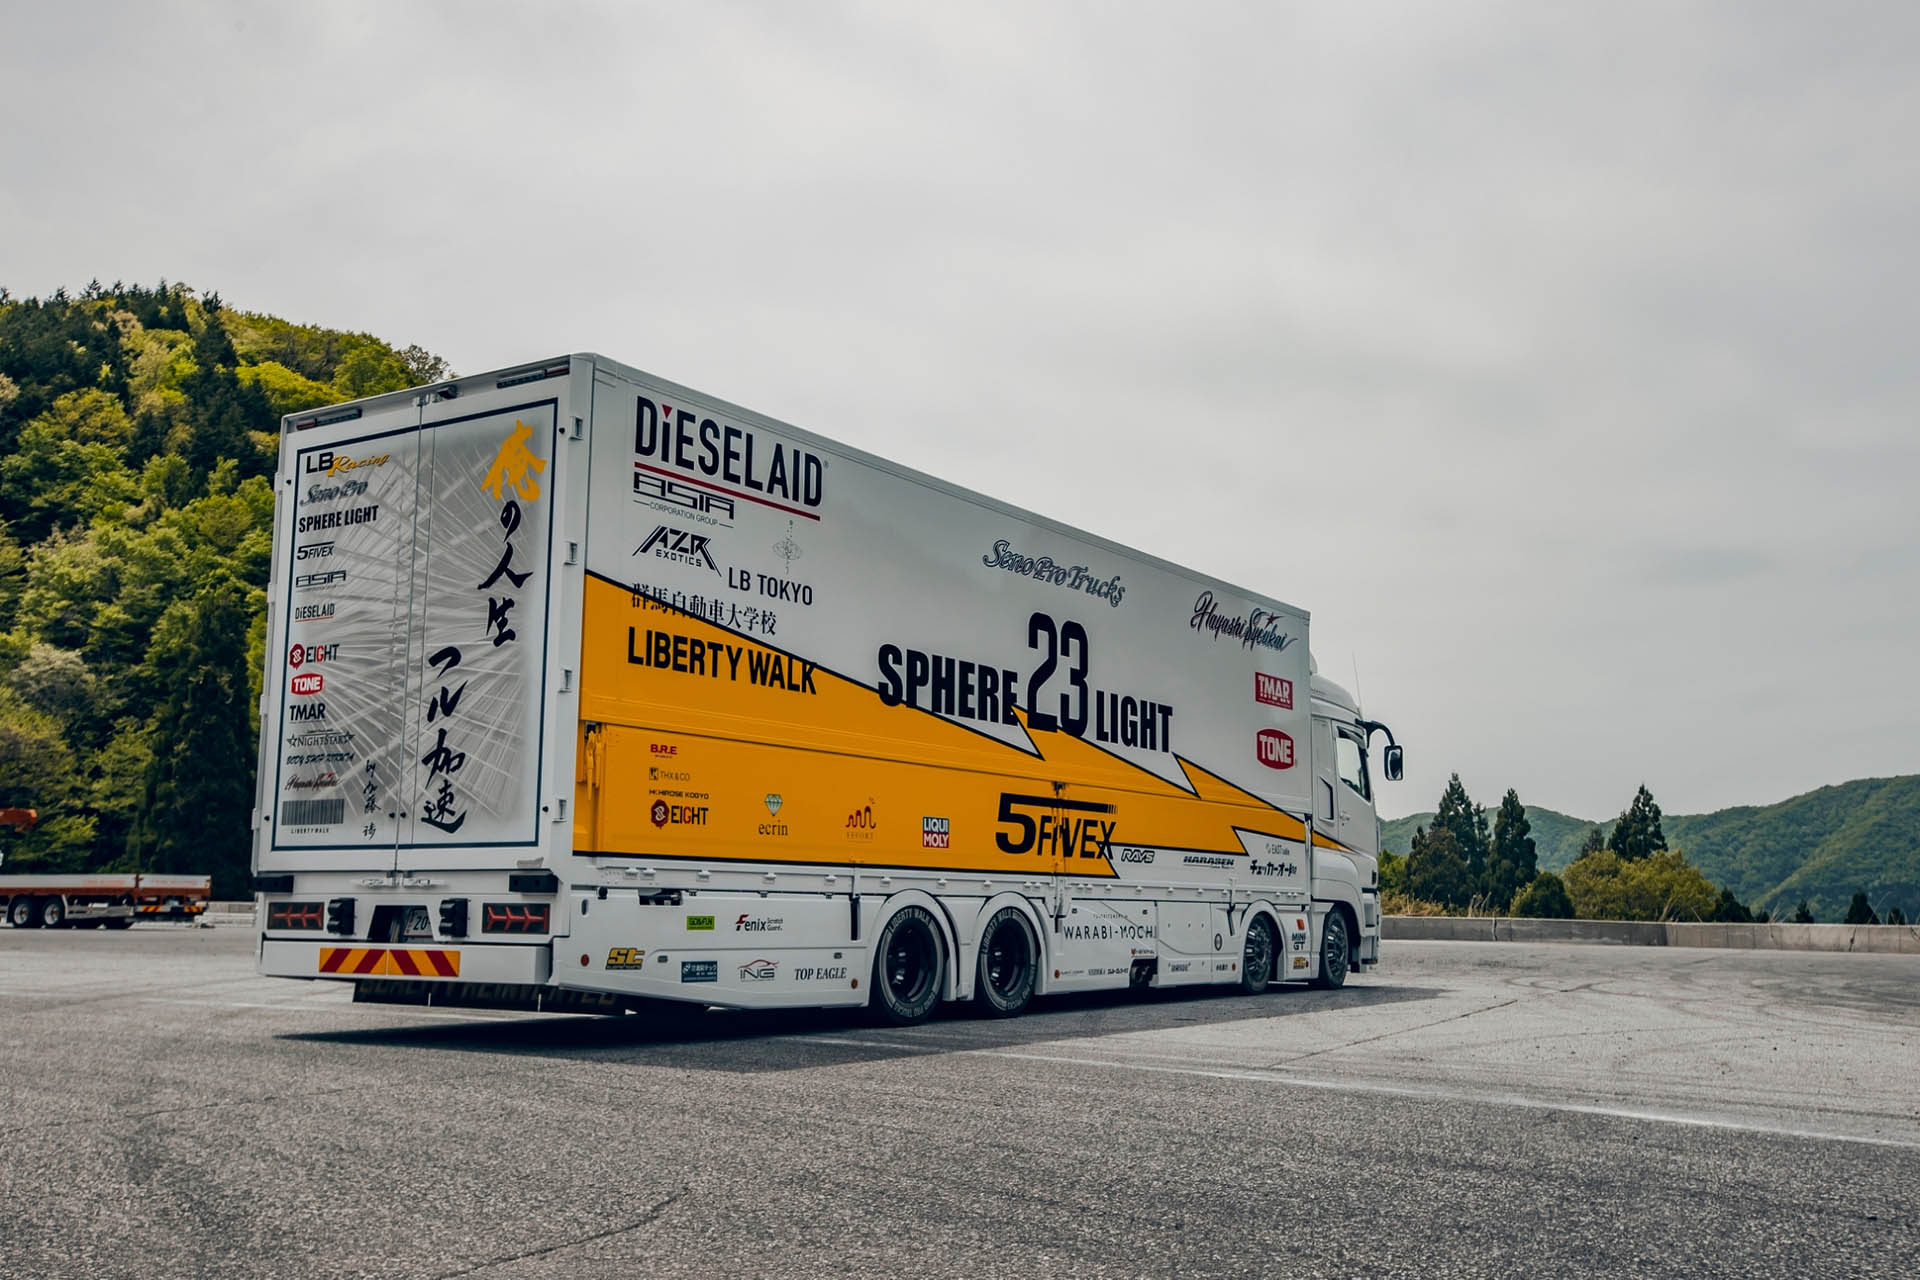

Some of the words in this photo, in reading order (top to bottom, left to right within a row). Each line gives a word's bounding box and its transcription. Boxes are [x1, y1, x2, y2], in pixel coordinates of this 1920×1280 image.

[306, 452, 333, 474] LB
[328, 454, 390, 477] Racing
[299, 511, 342, 533] SPHERE
[345, 505, 379, 526] LIGHT
[649, 501, 695, 520] CORPORATION
[696, 512, 718, 526] GROUP
[656, 549, 702, 568] EXOTICS
[983, 540, 1034, 576] Seno
[1033, 557, 1066, 586] Pro
[1067, 566, 1125, 607] Trucks
[729, 567, 750, 591] LB
[757, 573, 812, 606] TOKYO
[631, 582, 776, 636] 群馬自動車大学校
[306, 645, 340, 663] EIGHT
[628, 626, 743, 681] LIBERTY
[748, 649, 817, 695] WALK
[294, 677, 321, 691] TONE
[877, 644, 1021, 728] SPHERE
[1027, 612, 1089, 739] 23
[1096, 690, 1173, 754] LIGHT
[290, 703, 325, 720] TMAR
[1259, 735, 1291, 765] TONE
[671, 805, 709, 825] EIGHT
[923, 818, 949, 832] LIQUI
[923, 833, 949, 847] MOLY
[1121, 848, 1155, 863] RAYS
[735, 914, 767, 931] Fenix
[1063, 925, 1157, 941] WARABI-MOCHI
[1294, 941, 1305, 950] GT
[740, 966, 775, 979] ING
[794, 968, 813, 980] TOP
[816, 967, 847, 980] EAGLE
